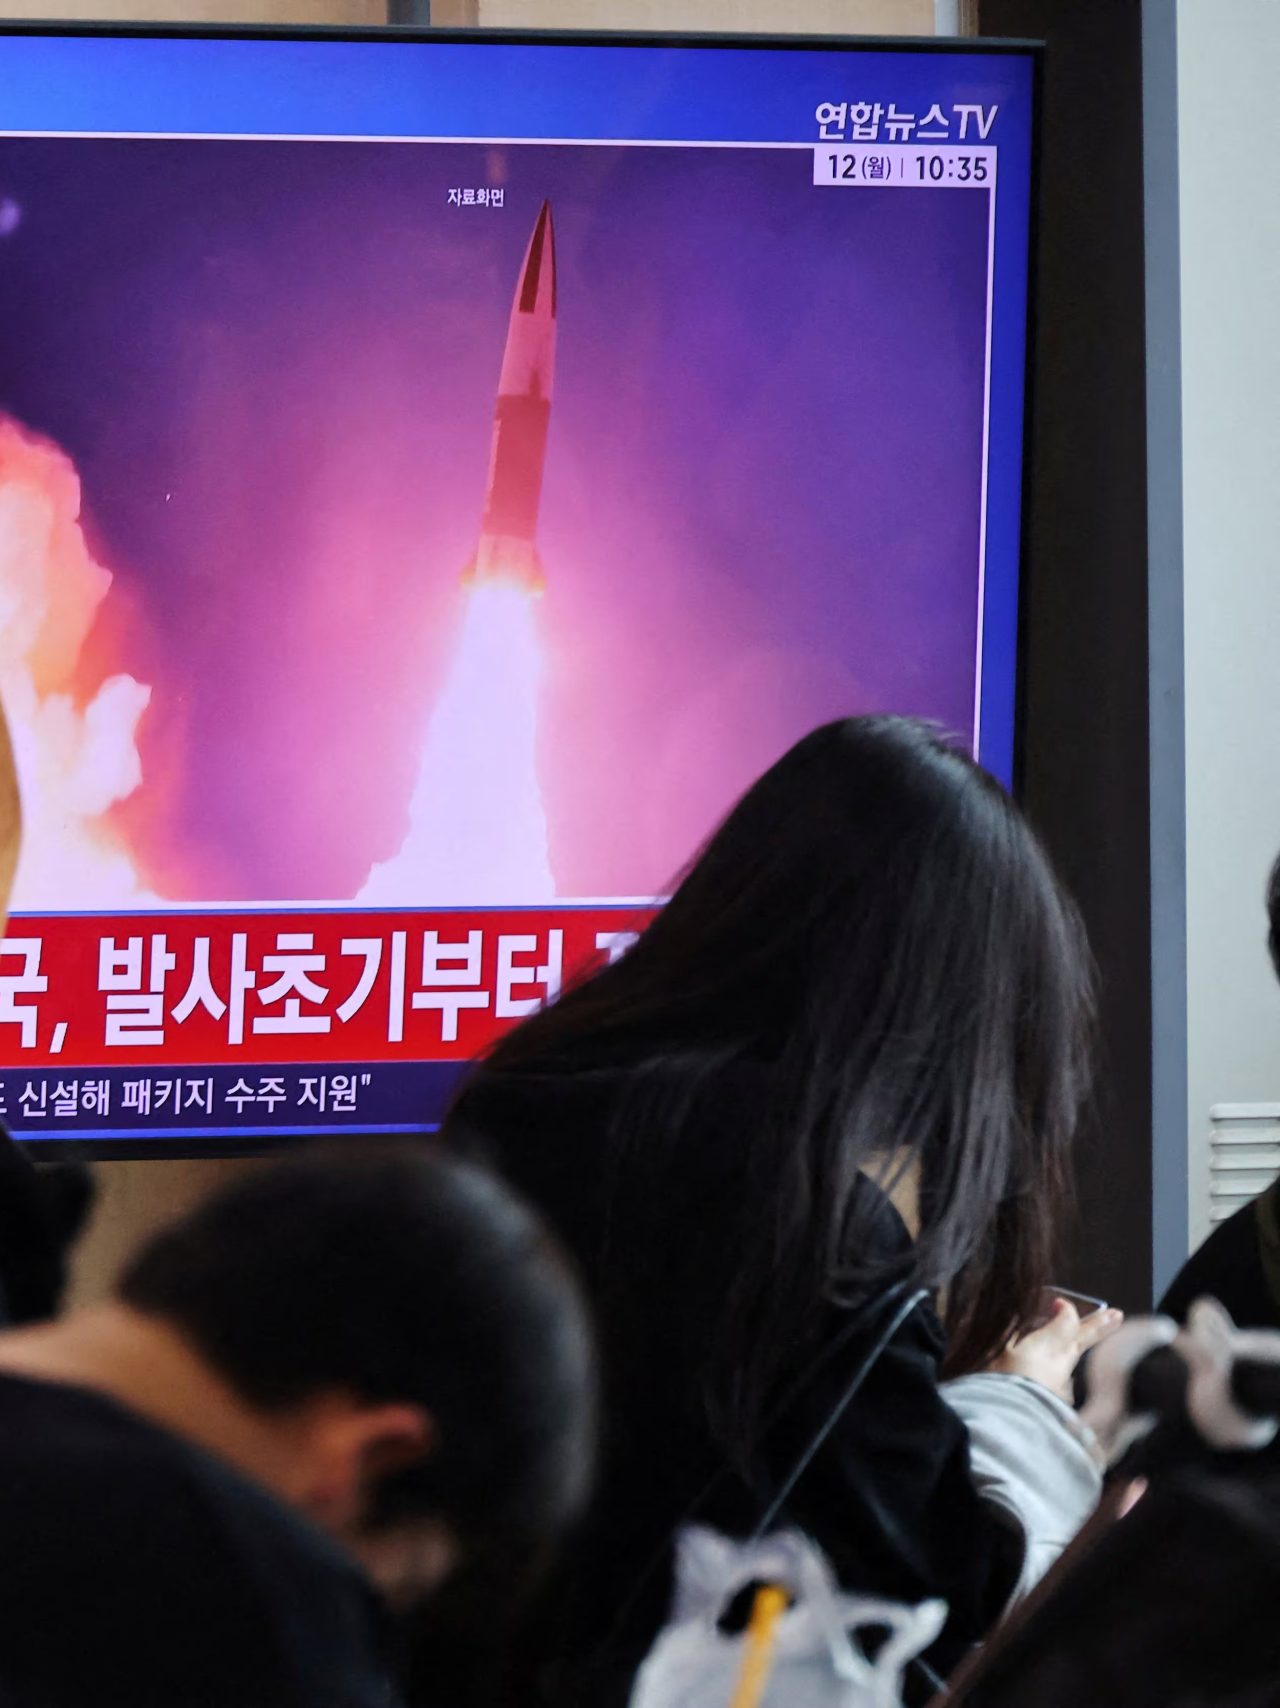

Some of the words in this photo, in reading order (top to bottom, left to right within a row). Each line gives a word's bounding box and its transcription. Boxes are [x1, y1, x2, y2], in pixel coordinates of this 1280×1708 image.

[815, 101, 998, 141] 연합뉴스TV
[916, 155, 988, 181] 10:35
[447, 187, 504, 207] 자료화면
[96, 929, 564, 1046] 발사초기부터
[18, 1079, 111, 1117] 신설해
[121, 1077, 214, 1116] 패키지
[225, 1075, 287, 1115] 수주
[296, 1073, 371, 1112] 지원"
